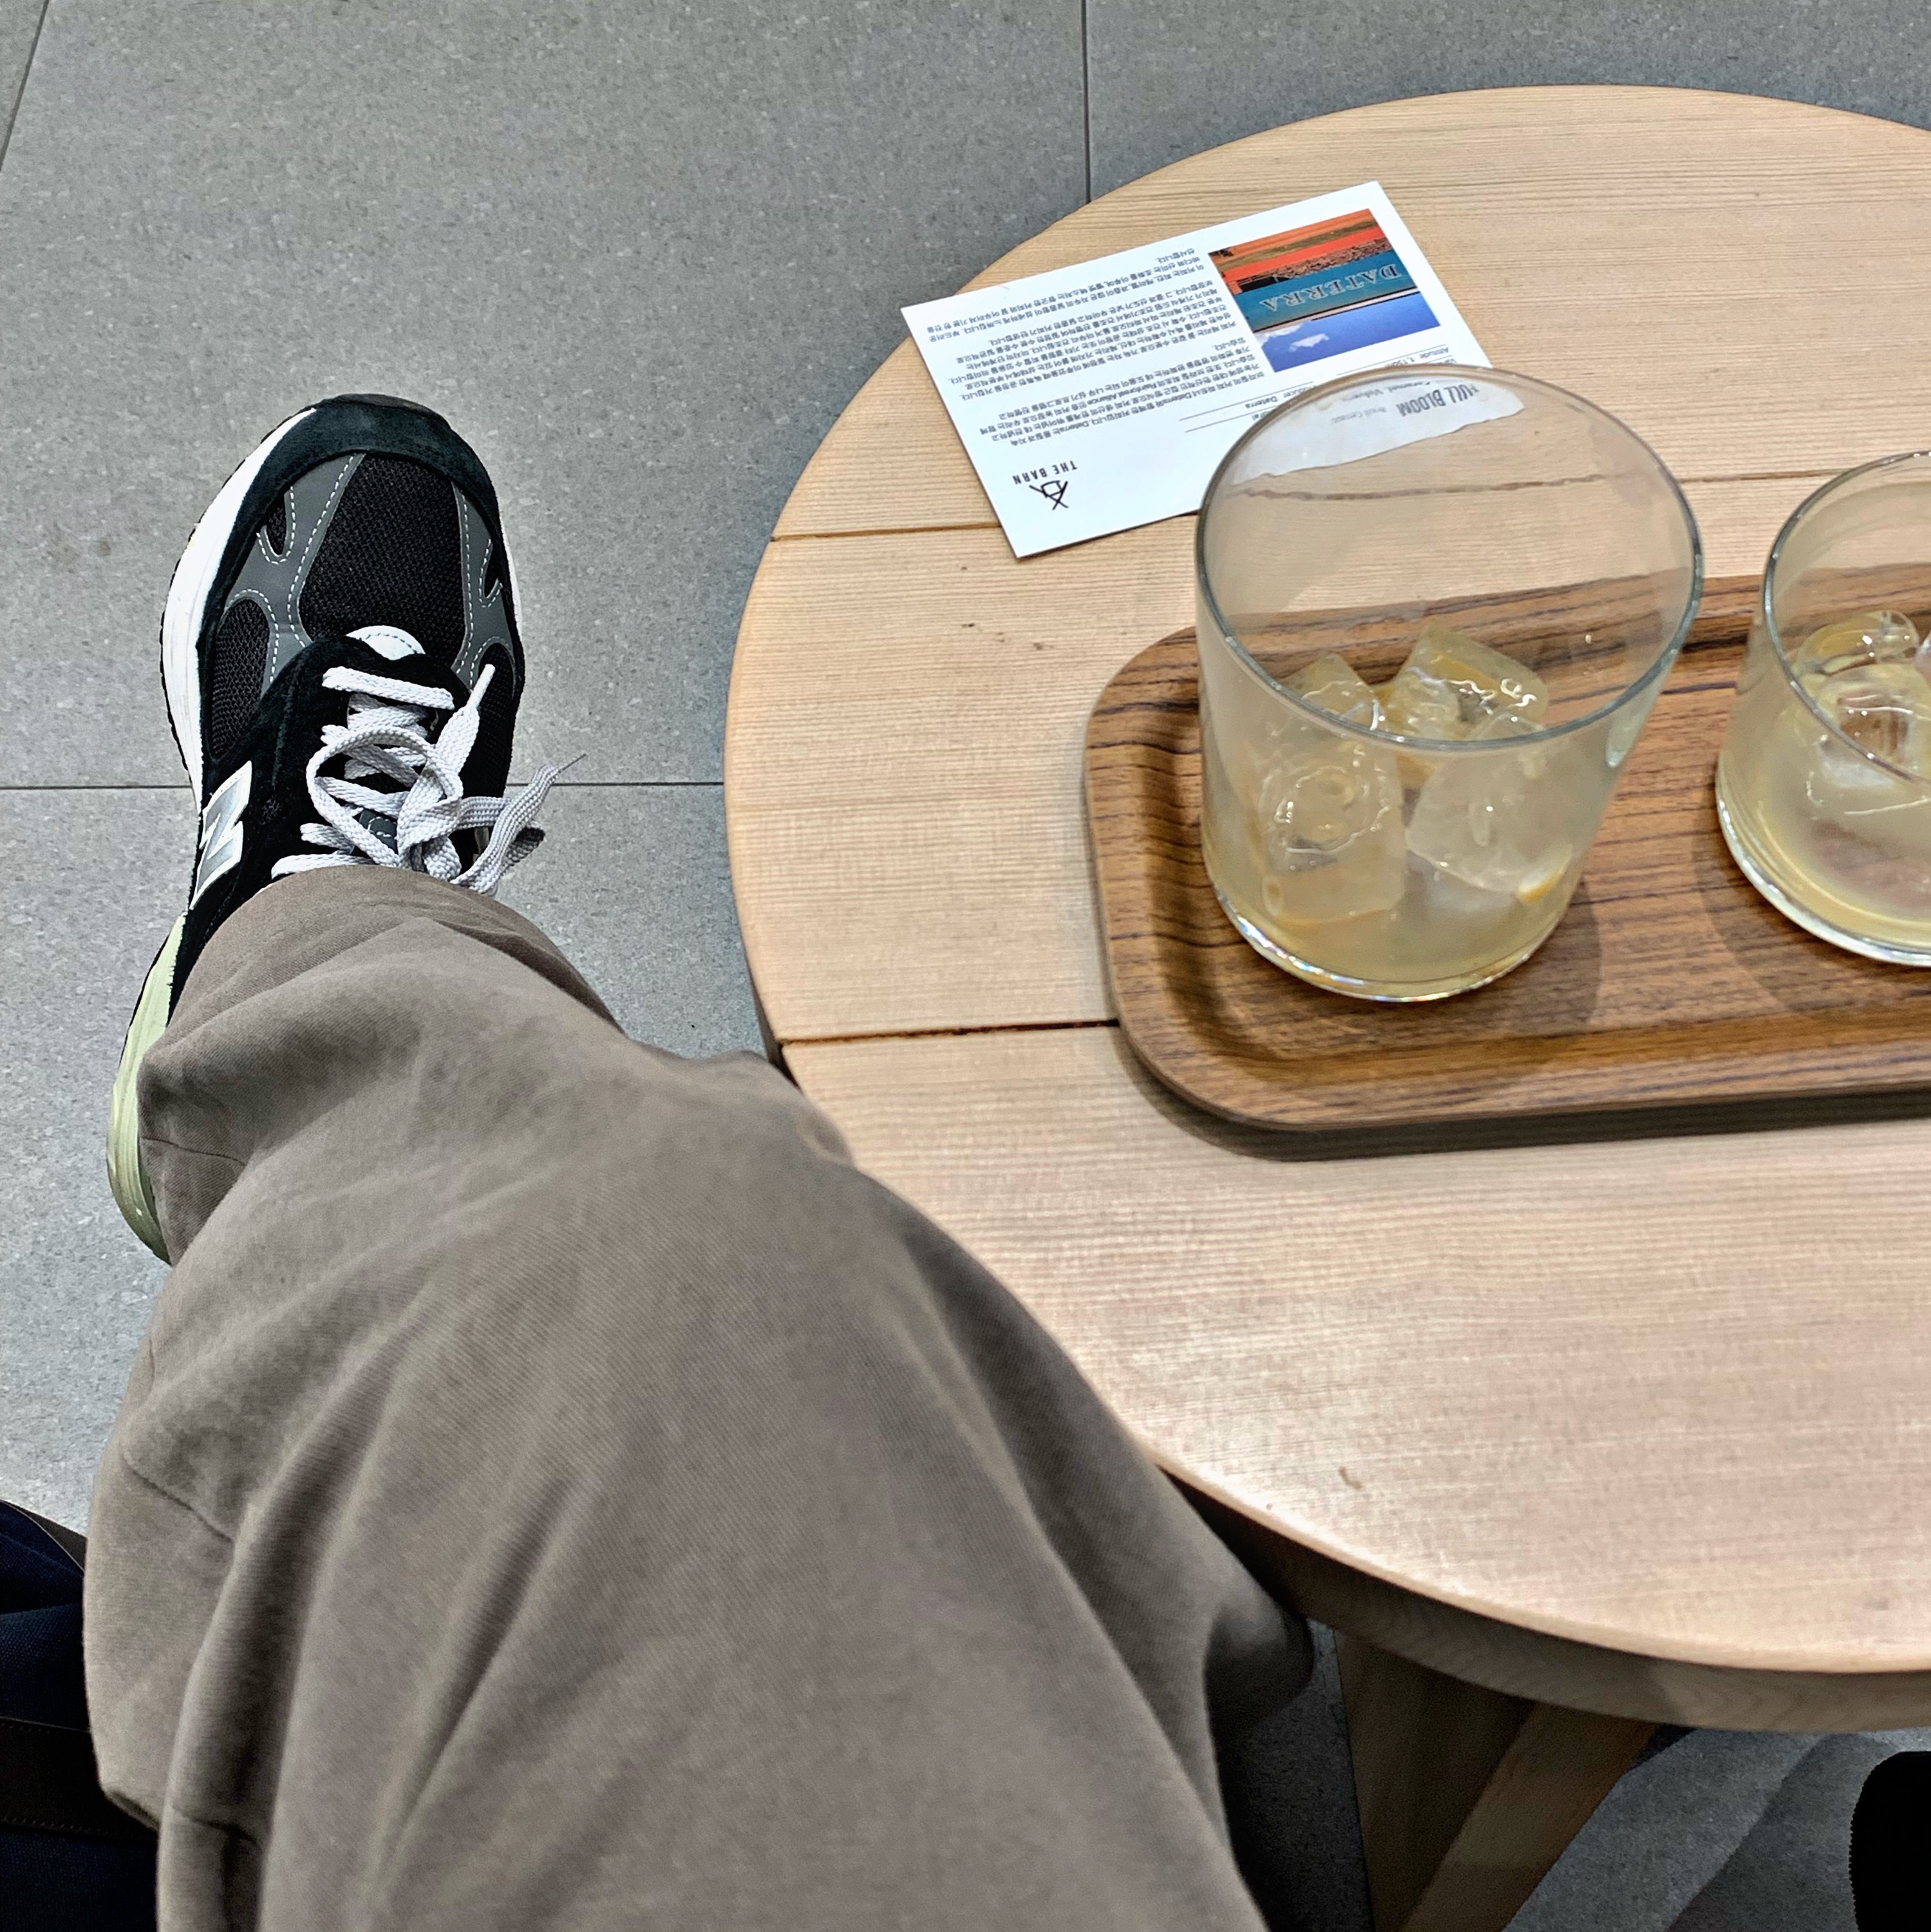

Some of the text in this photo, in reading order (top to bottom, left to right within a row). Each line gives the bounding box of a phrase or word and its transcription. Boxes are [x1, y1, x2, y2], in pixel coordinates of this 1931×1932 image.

[1259, 263, 1402, 312] DATERRA
[1245, 396, 1277, 408] Daterra
[1396, 389, 1446, 416] BLOOM
[1012, 460, 1078, 485] THE BARN
